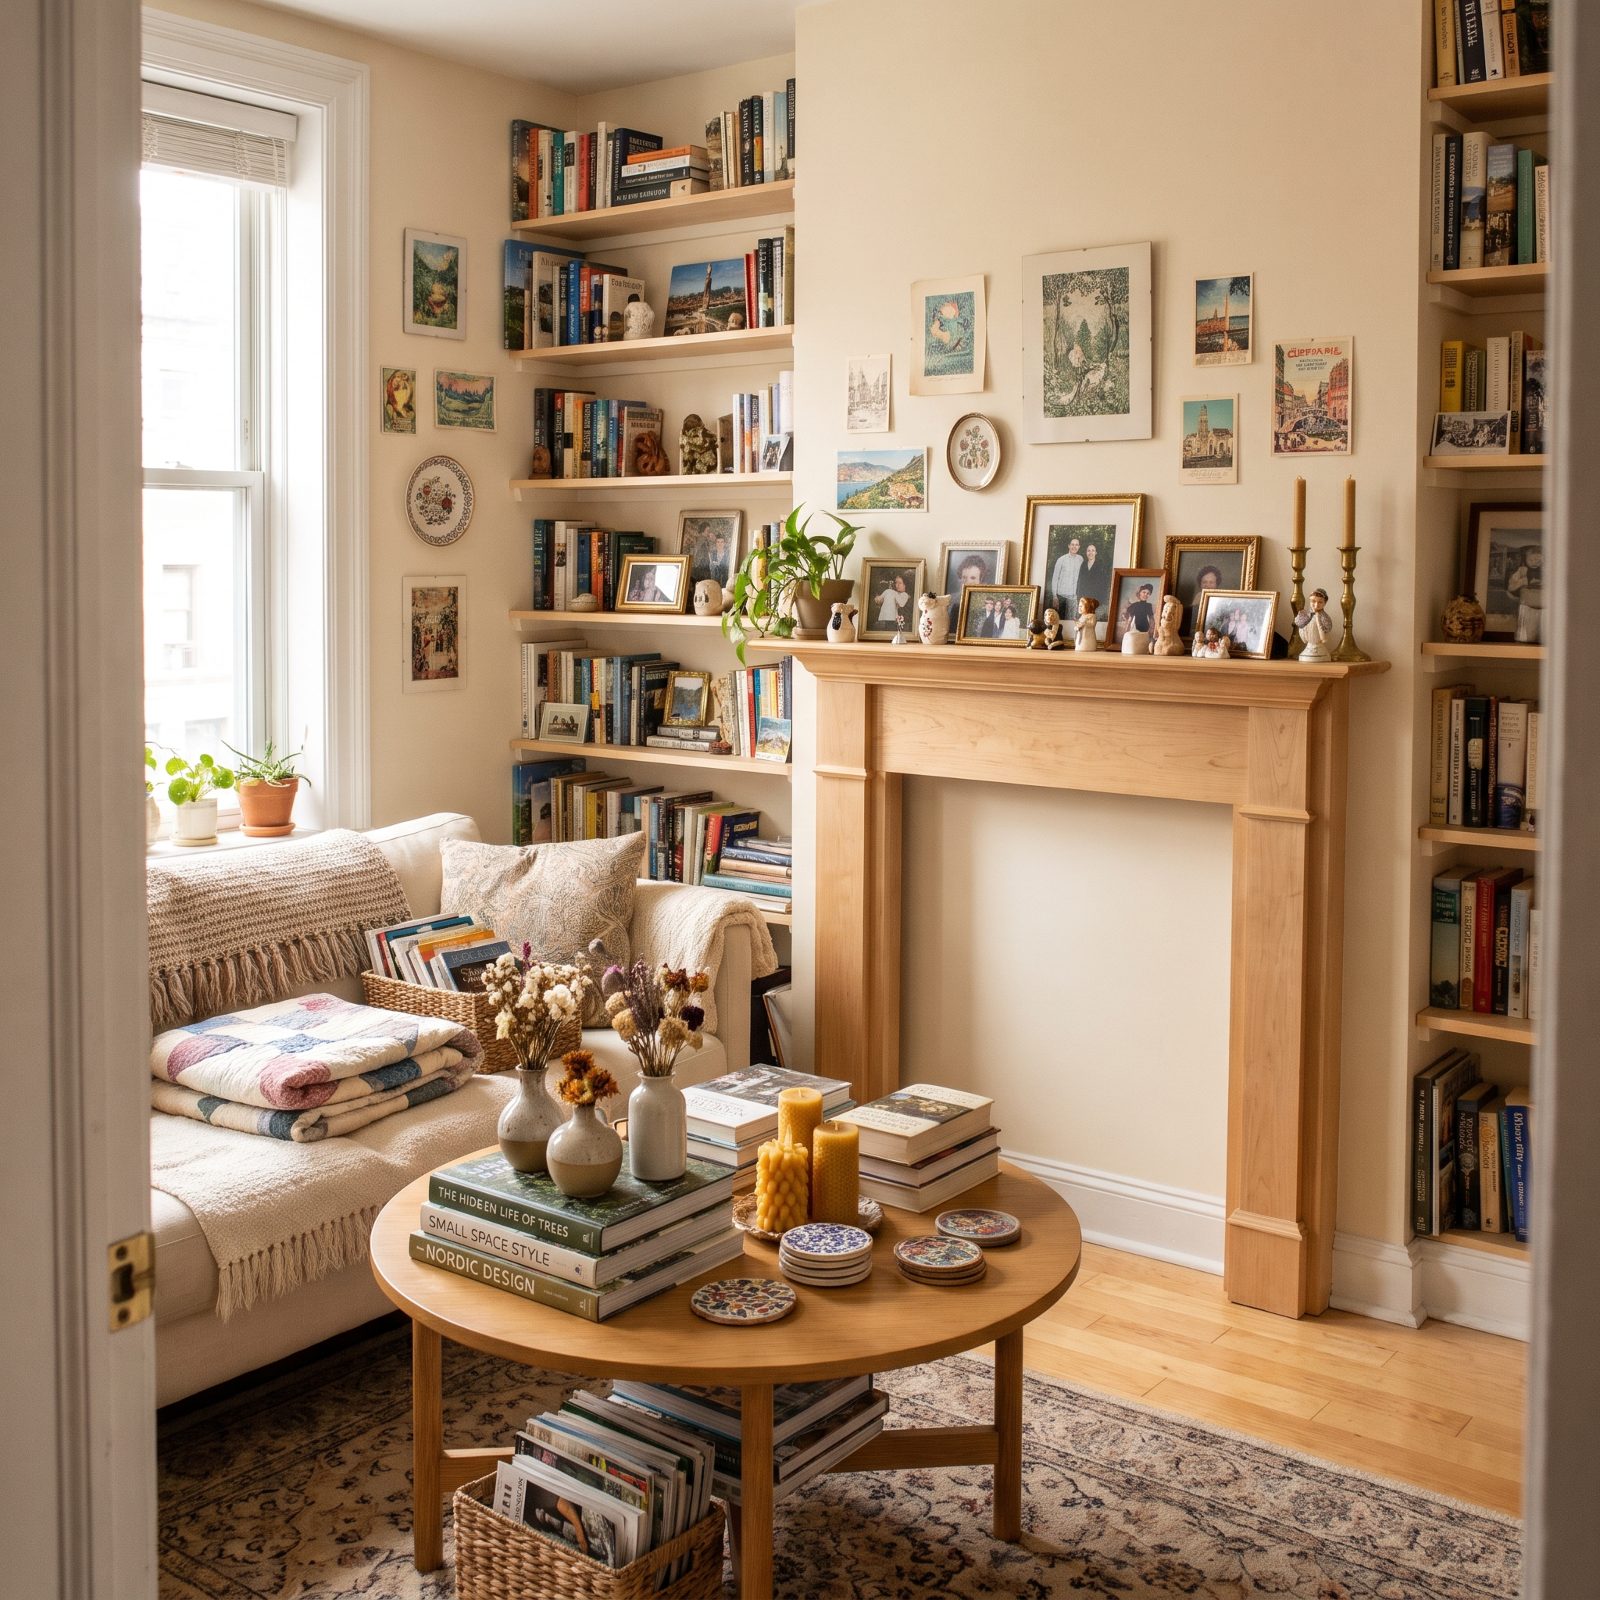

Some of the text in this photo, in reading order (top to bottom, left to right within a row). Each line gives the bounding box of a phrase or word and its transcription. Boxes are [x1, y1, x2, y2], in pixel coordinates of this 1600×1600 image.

[438, 1186, 456, 1201] THE
[500, 1206, 520, 1222] LIFE
[522, 1213, 536, 1226] OF
[538, 1218, 569, 1238] TREES
[428, 1215, 550, 1267] SMALL SPACE STYLE
[426, 1244, 479, 1276] NORDIC
[483, 1264, 536, 1295] DESIGN
